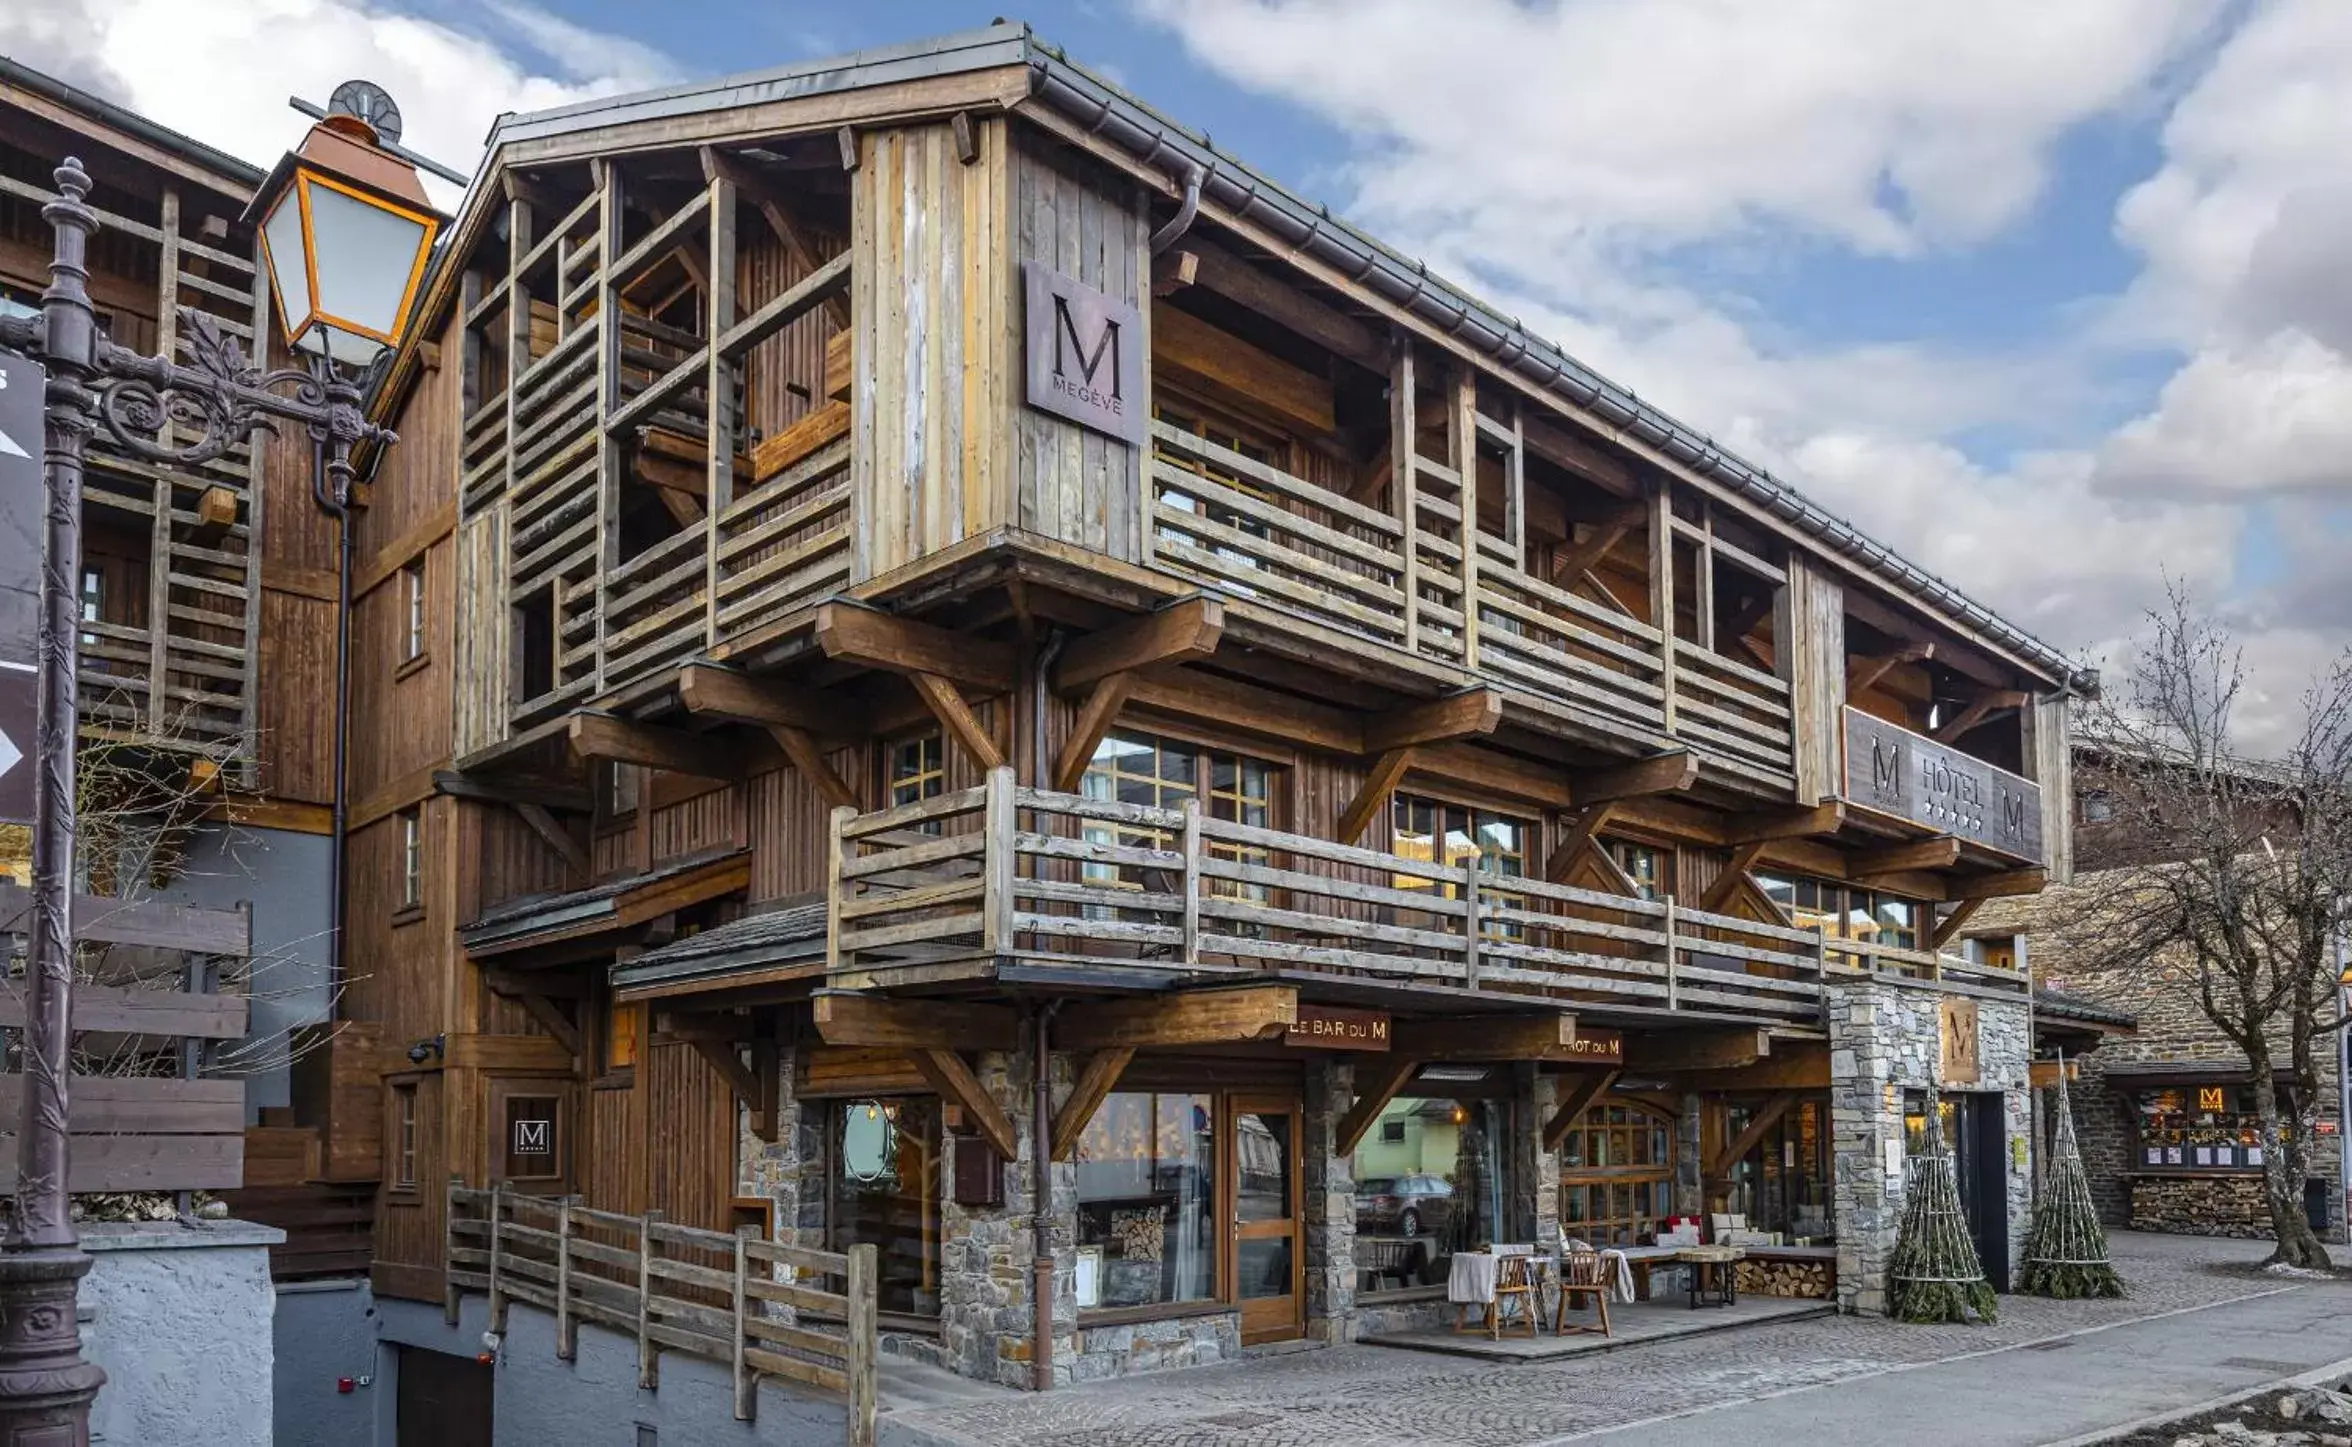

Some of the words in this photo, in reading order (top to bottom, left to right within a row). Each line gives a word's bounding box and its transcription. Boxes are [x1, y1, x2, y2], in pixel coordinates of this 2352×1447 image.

[1052, 292, 1121, 400] M
[1053, 376, 1123, 416] MEGÈVE
[1871, 734, 1900, 798] M
[1923, 756, 1984, 809] HÔTEL
[2001, 786, 2024, 842] M
[1313, 1020, 1344, 1036] BAR
[1372, 1021, 1386, 1039] M
[1609, 1040, 1619, 1054] M
[2200, 1088, 2222, 1104] M
[520, 1123, 545, 1145] M
